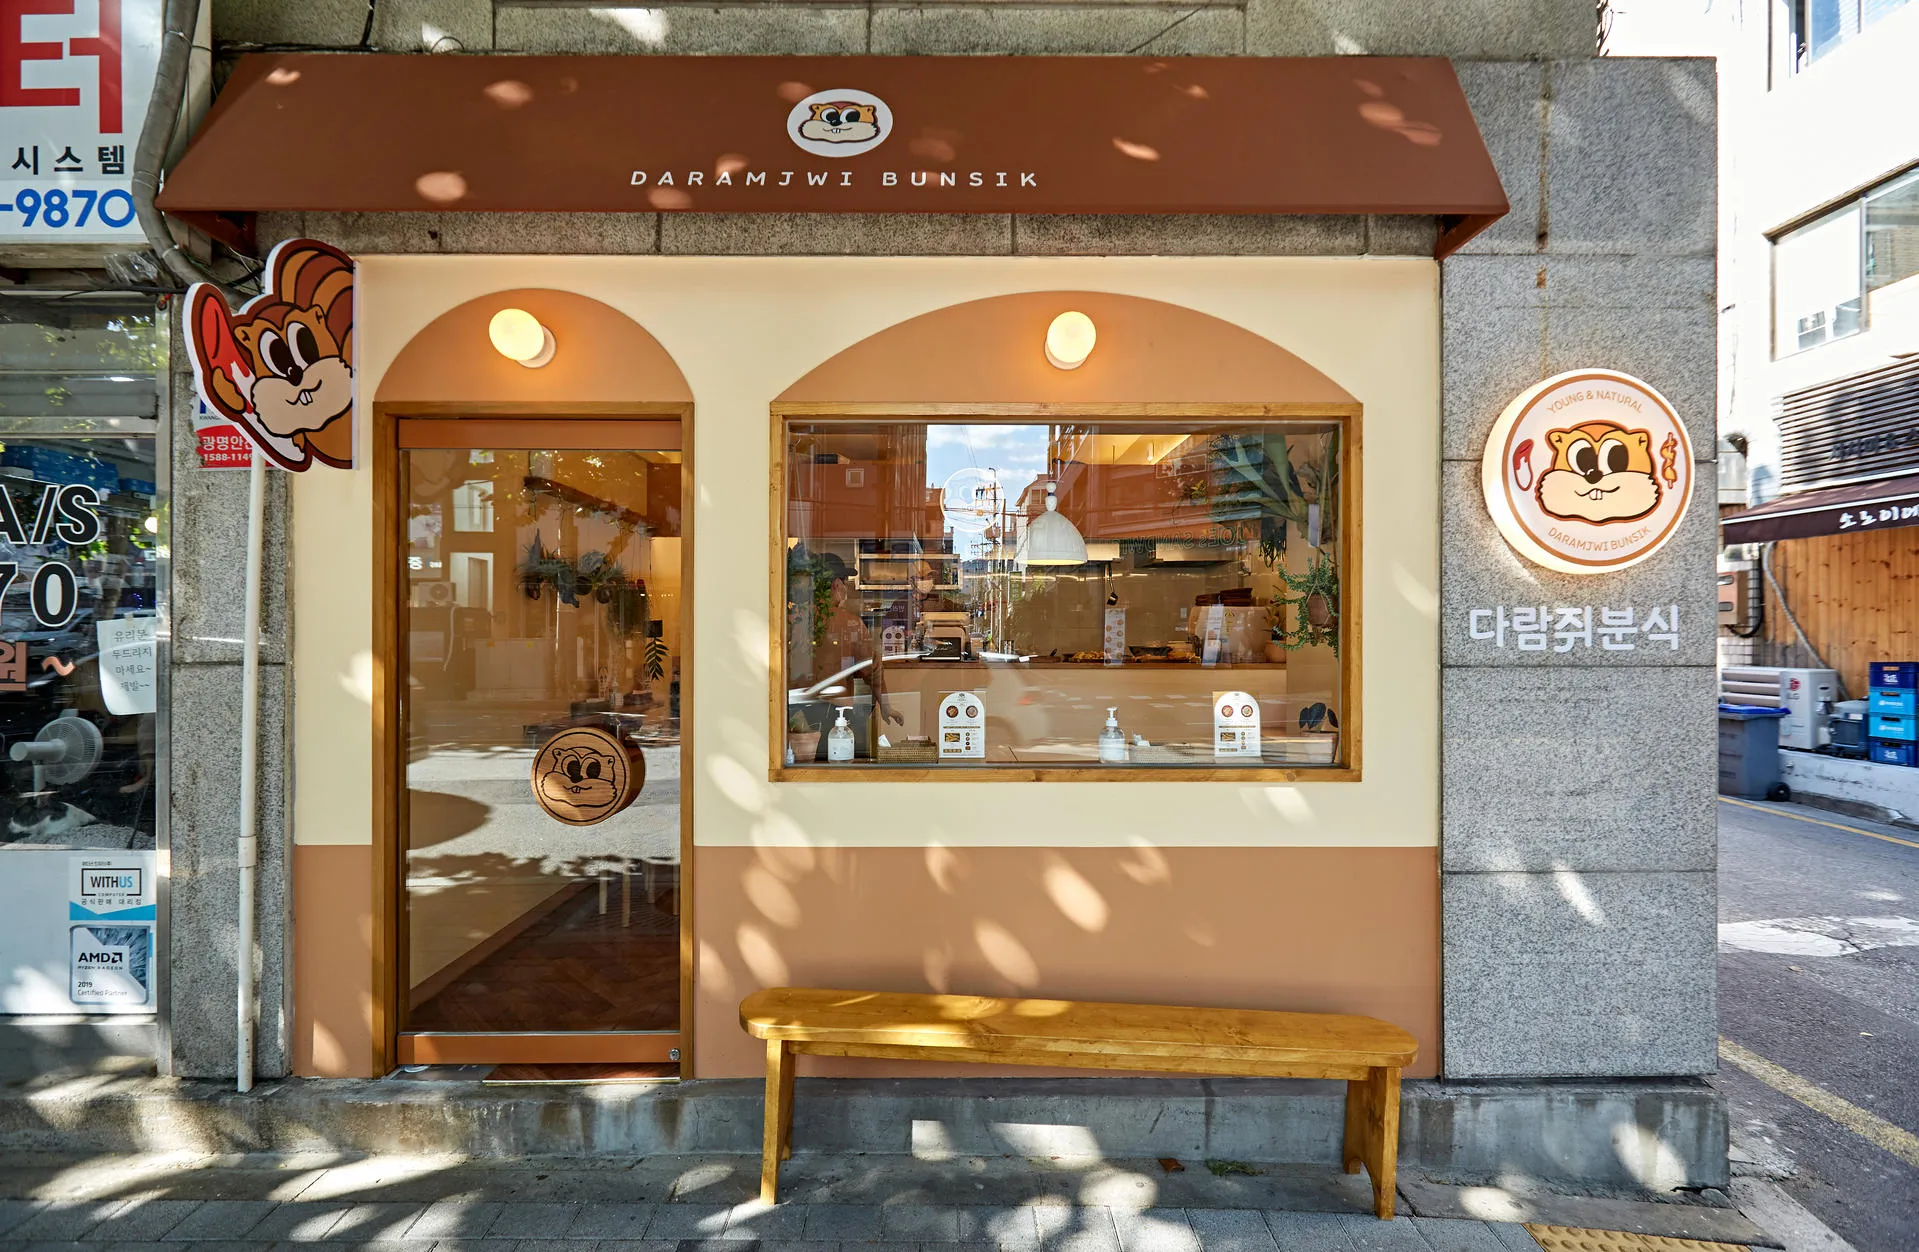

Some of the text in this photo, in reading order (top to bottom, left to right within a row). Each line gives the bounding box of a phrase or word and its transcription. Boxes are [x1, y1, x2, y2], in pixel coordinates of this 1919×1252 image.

[11, 144, 126, 175] 시스템
[630, 170, 1038, 188] DARAMJWI BUNSIK
[1547, 390, 1644, 414] YOUNG & NATURAL
[1548, 526, 1651, 552] DARAMJWI BUNSIK
[1469, 604, 1680, 653] 다람쥐분식
[90, 876, 133, 888] WITHUS
[78, 952, 111, 963] AMD
